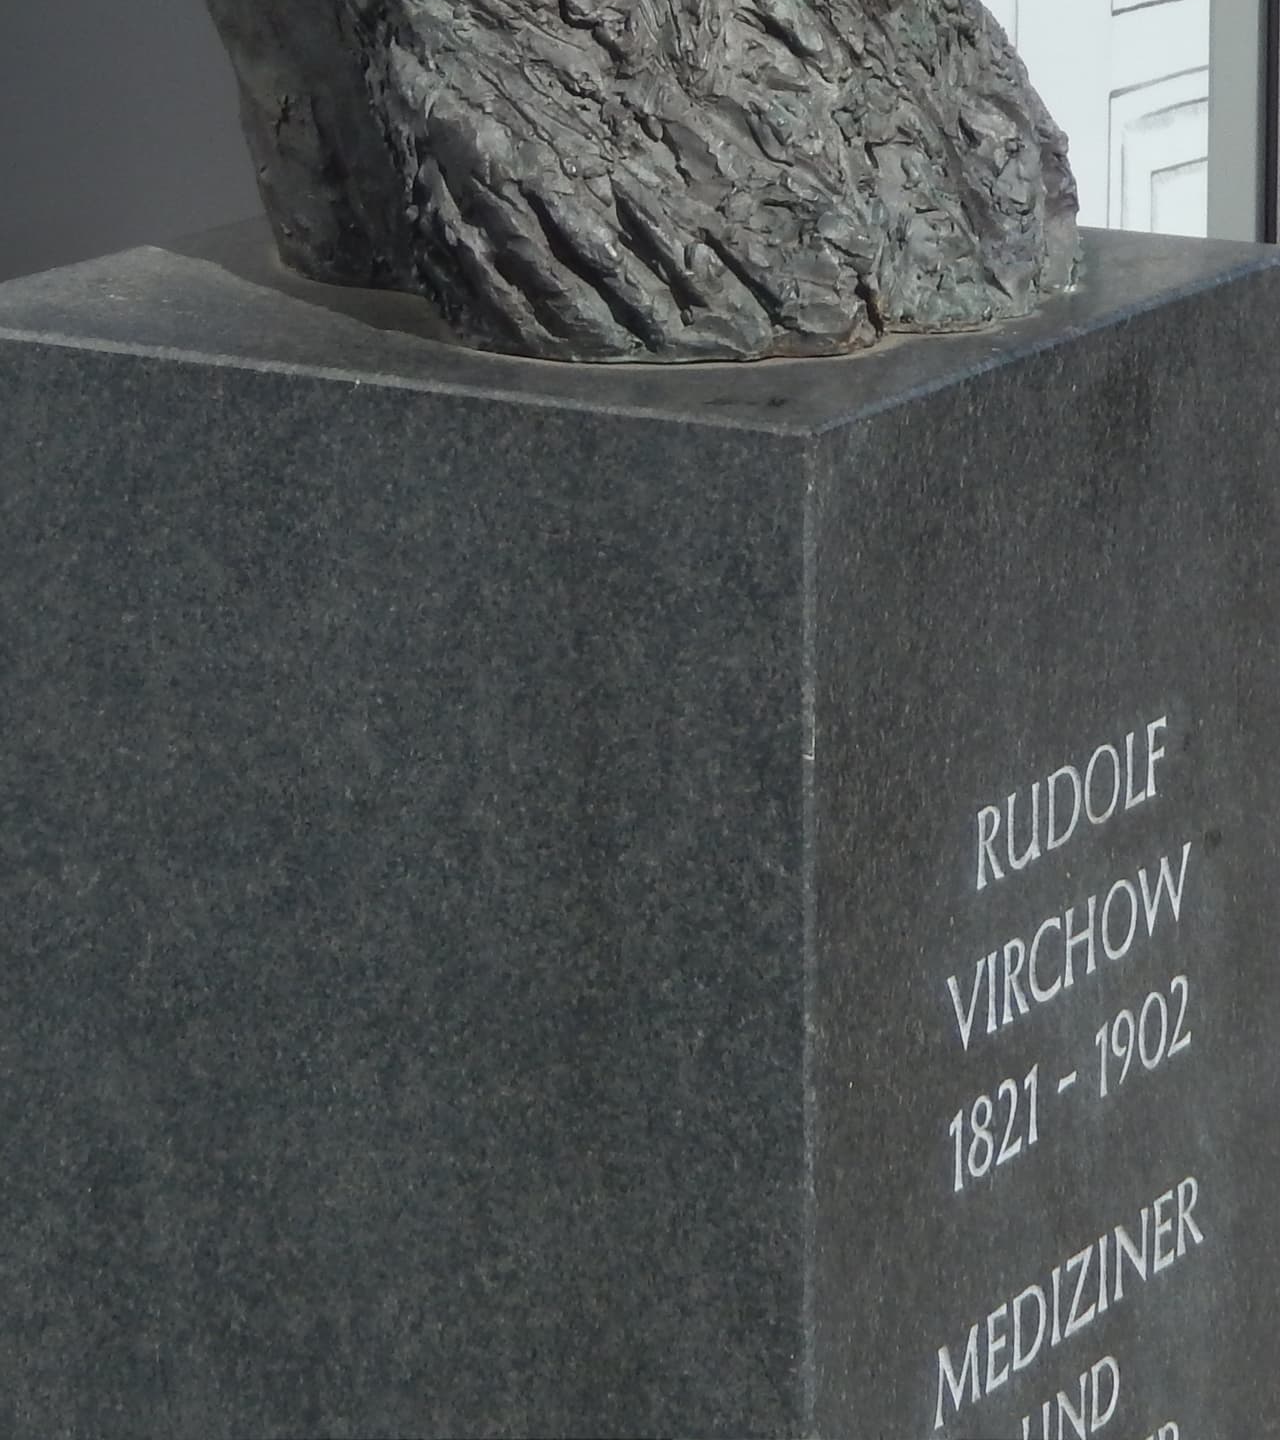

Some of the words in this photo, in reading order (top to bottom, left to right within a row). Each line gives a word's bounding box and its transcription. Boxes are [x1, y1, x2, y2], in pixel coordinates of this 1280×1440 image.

[975, 714, 1168, 892] RUDOLF
[945, 841, 1192, 1052] VIRCHOW
[948, 1063, 1039, 1194] 1821
[1056, 1070, 1078, 1095] -
[1094, 974, 1192, 1099] 1902
[933, 1176, 1205, 1432] MEDIZINER
